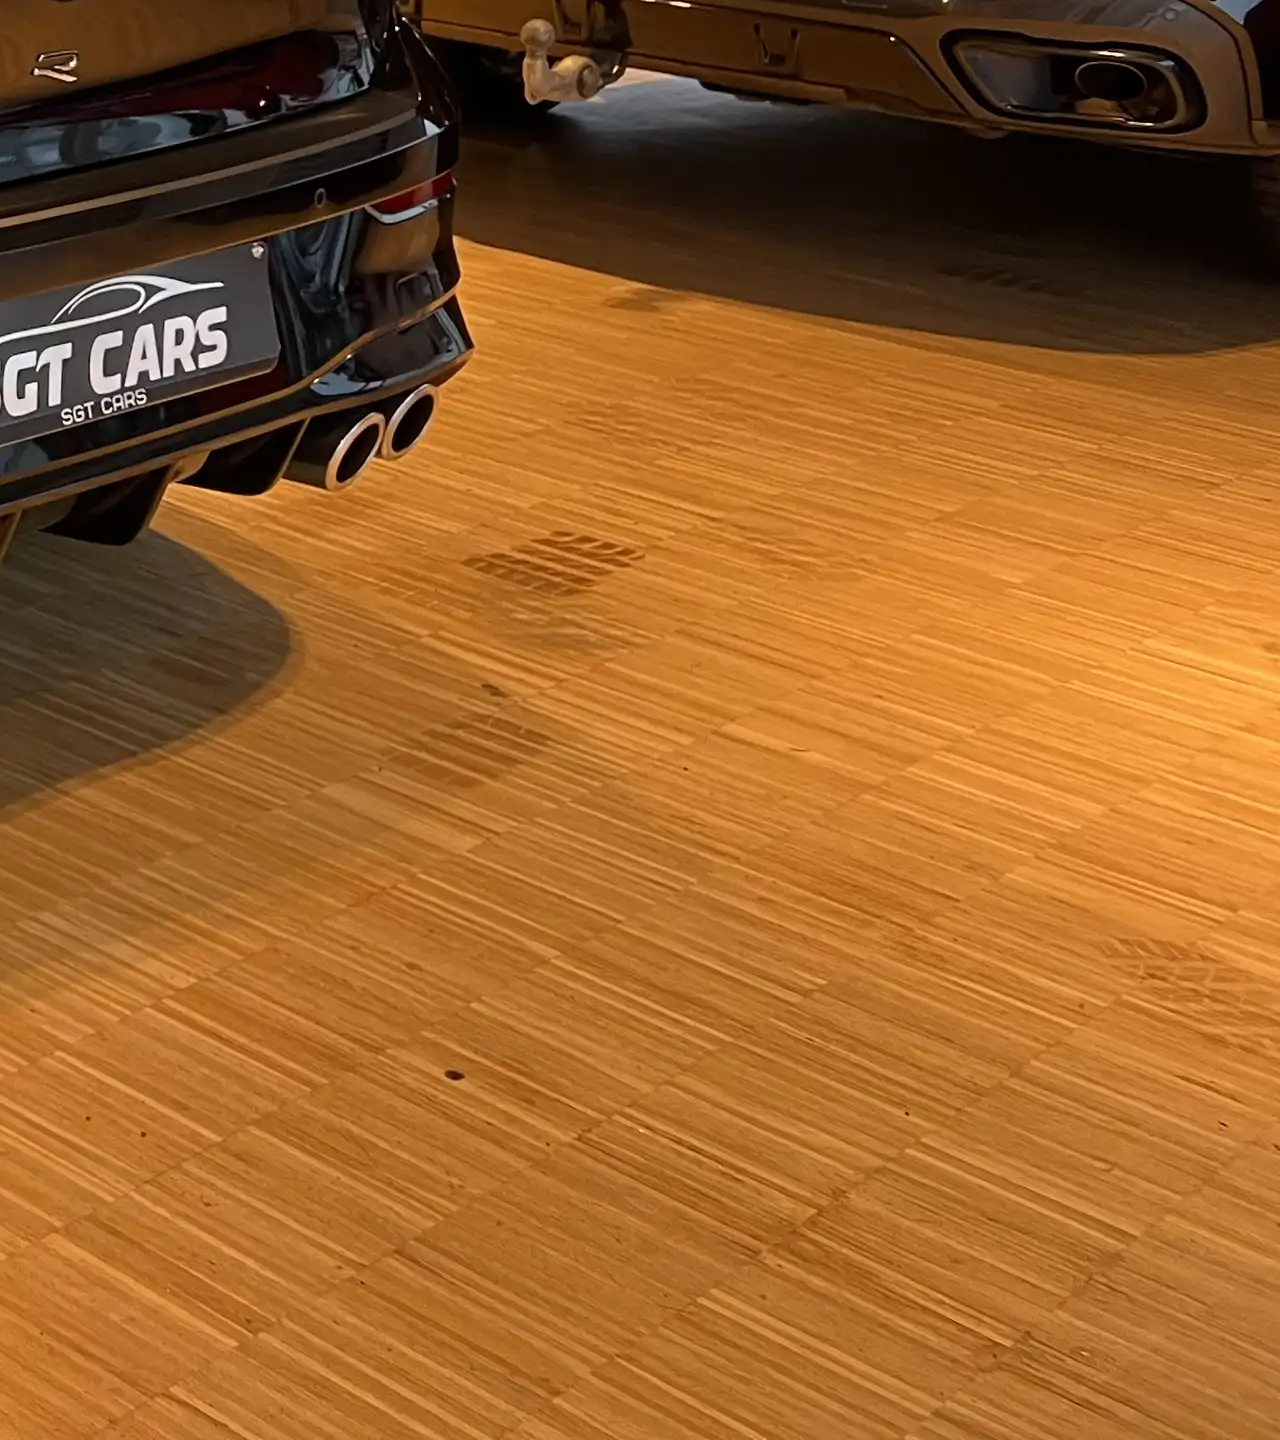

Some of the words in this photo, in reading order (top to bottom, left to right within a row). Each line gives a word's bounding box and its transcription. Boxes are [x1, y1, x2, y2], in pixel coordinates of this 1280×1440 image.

[88, 305, 228, 395] CARS
[60, 401, 95, 427] SGT
[100, 388, 148, 415] CARS
